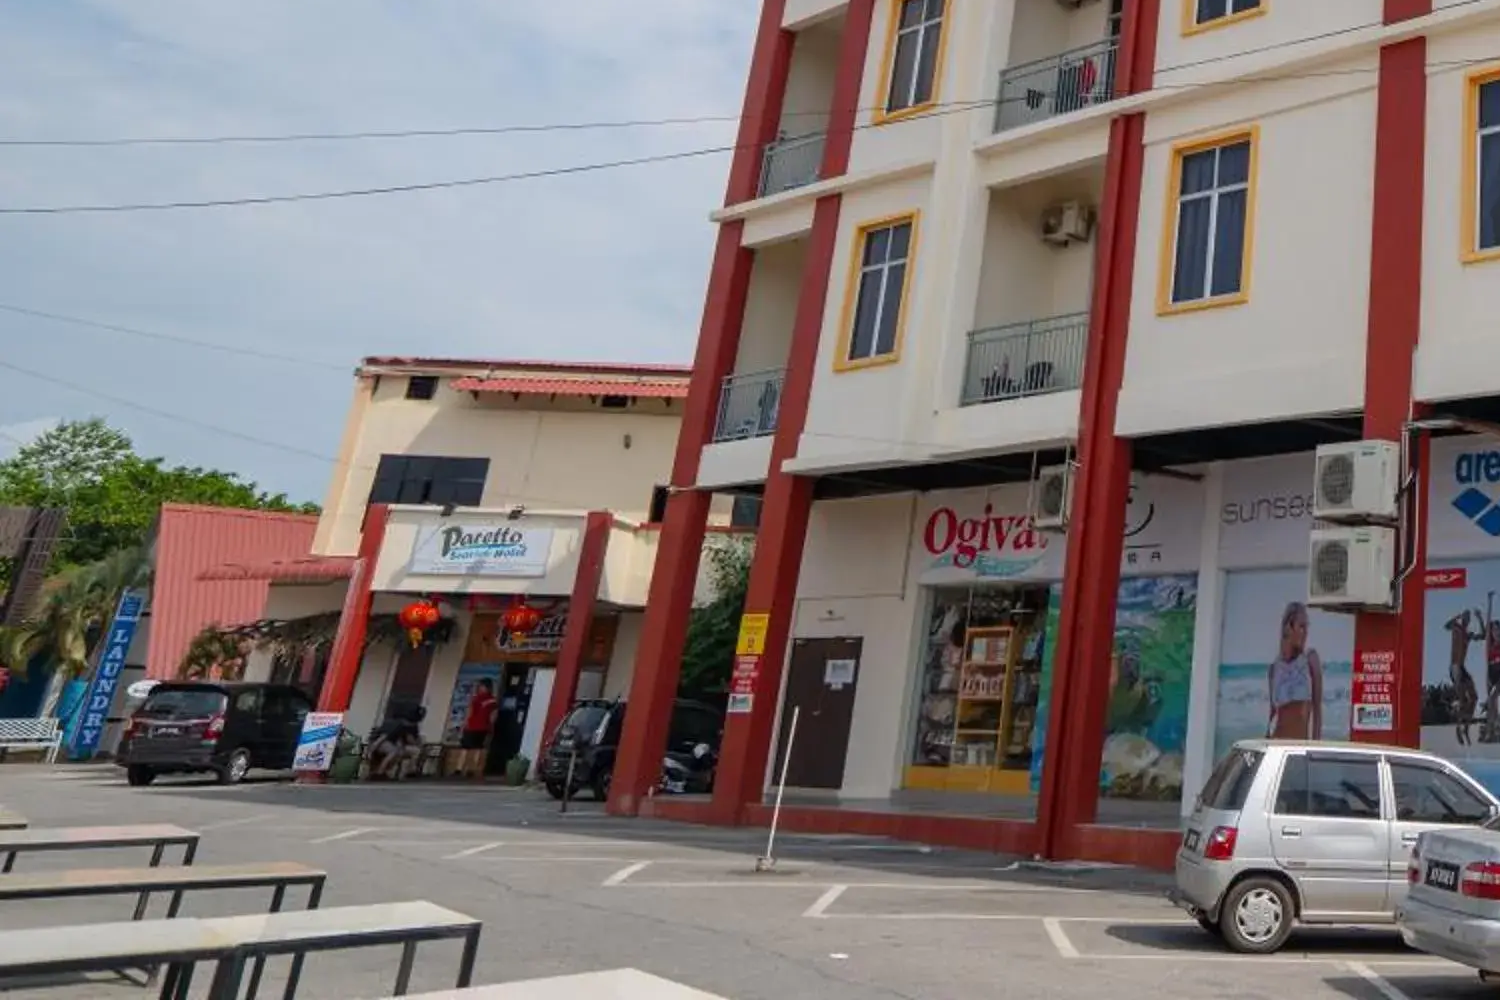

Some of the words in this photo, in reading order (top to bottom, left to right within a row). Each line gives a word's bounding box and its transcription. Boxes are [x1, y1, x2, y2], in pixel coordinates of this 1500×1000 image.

[441, 526, 522, 557] Paretto
[924, 503, 1050, 568] Ogiva
[82, 629, 129, 746] LAUNDRY
